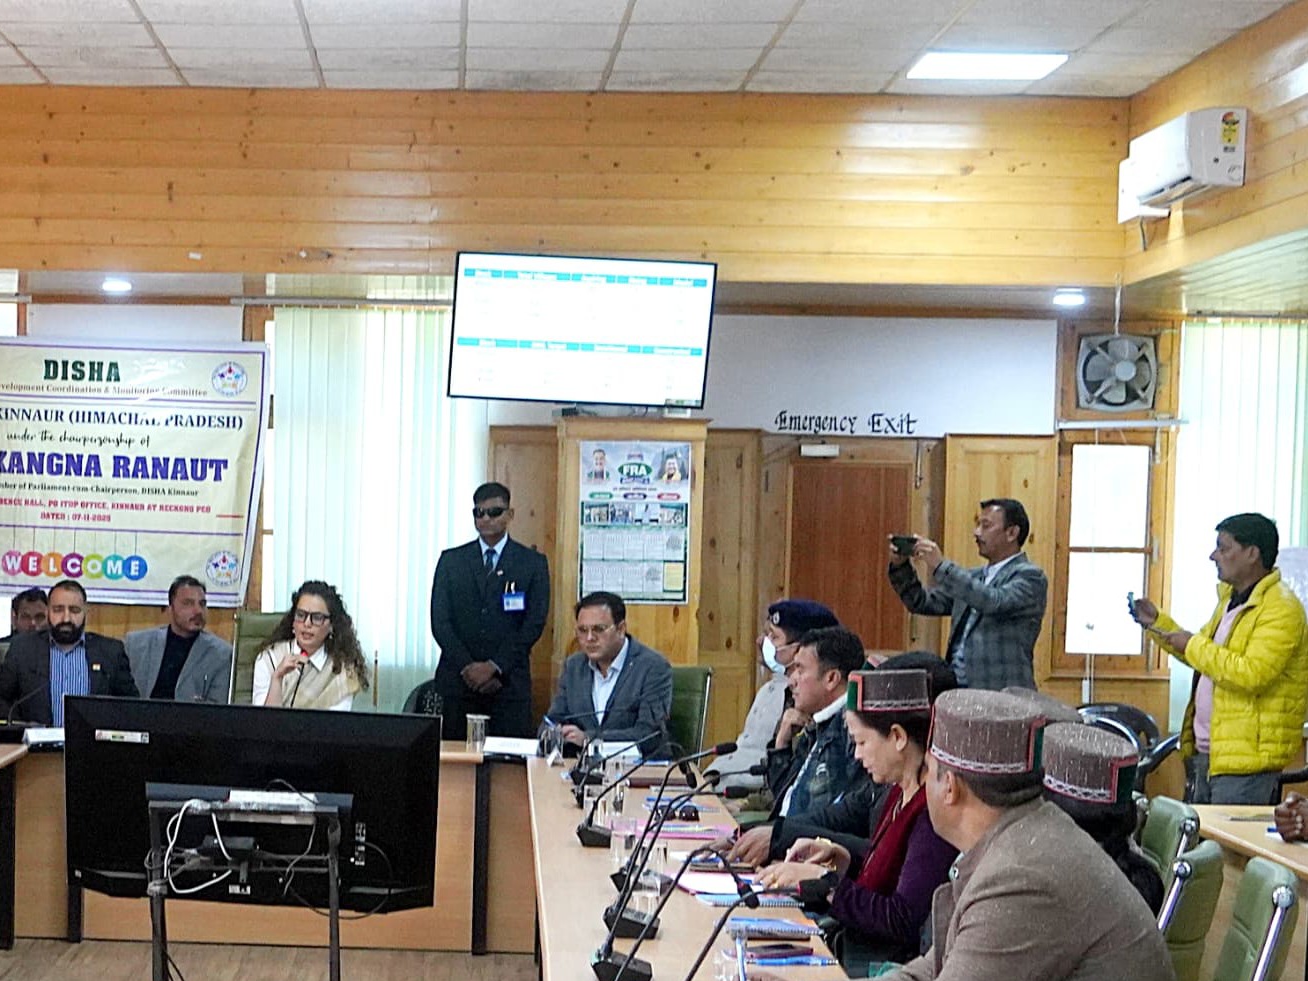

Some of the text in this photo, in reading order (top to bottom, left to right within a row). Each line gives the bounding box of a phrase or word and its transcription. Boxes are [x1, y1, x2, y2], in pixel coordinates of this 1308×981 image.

[43, 359, 121, 382] DISHA
[46, 384, 102, 394] Coordination
[68, 409, 160, 426] (HIMACHAL
[165, 413, 243, 431] PRADESH)
[774, 410, 918, 435] Emergency Exit
[6, 428, 36, 442] under
[40, 429, 55, 442] the
[140, 434, 151, 449] of
[112, 454, 229, 482] RANAUT
[622, 464, 647, 476] FRA
[18, 482, 26, 490] of
[141, 487, 166, 496] DISHA
[167, 488, 199, 497] Kinnaur
[40, 512, 66, 521] DATED
[111, 503, 145, 512] KINNAUR
[146, 504, 157, 512] AT
[159, 504, 194, 513] RECKONG
[195, 505, 212, 513] PEO
[5, 555, 140, 576] WELCOME
